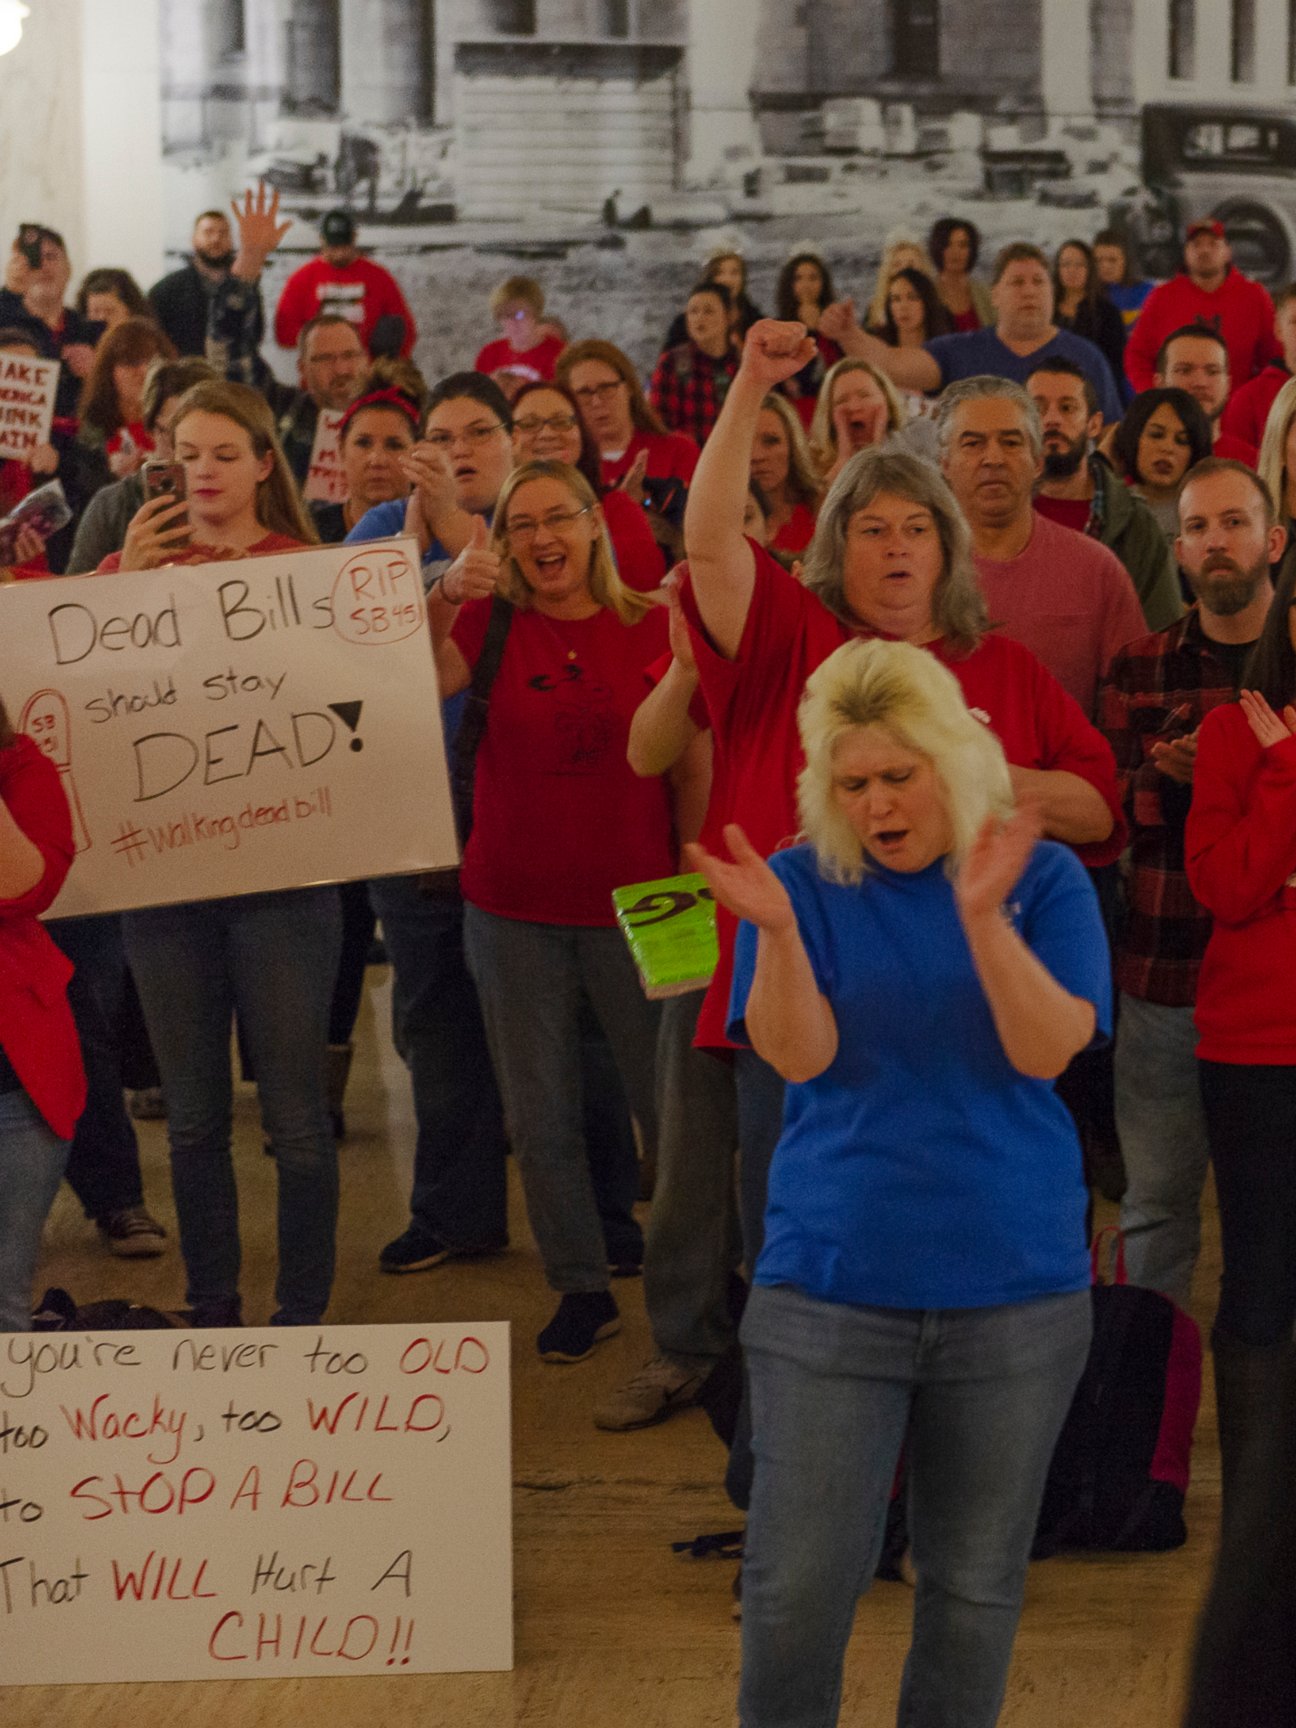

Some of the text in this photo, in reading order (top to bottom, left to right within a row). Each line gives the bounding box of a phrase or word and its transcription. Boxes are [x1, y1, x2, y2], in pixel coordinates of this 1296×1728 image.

[0, 361, 49, 386] AKE
[349, 561, 409, 601] RIP
[48, 574, 336, 665] Dead Bills
[31, 714, 56, 733] SB
[85, 676, 178, 724] should
[133, 700, 364, 803] DEAD!
[0, 1336, 490, 1397] you're never too OLD
[0, 1392, 452, 1464] too Wacky, too WILD,
[0, 1488, 43, 1523] to
[230, 1465, 263, 1511] A
[280, 1459, 393, 1508] BILL
[0, 1550, 412, 1613] That WILL Hurt A
[208, 1611, 416, 1666] CHILD!!
